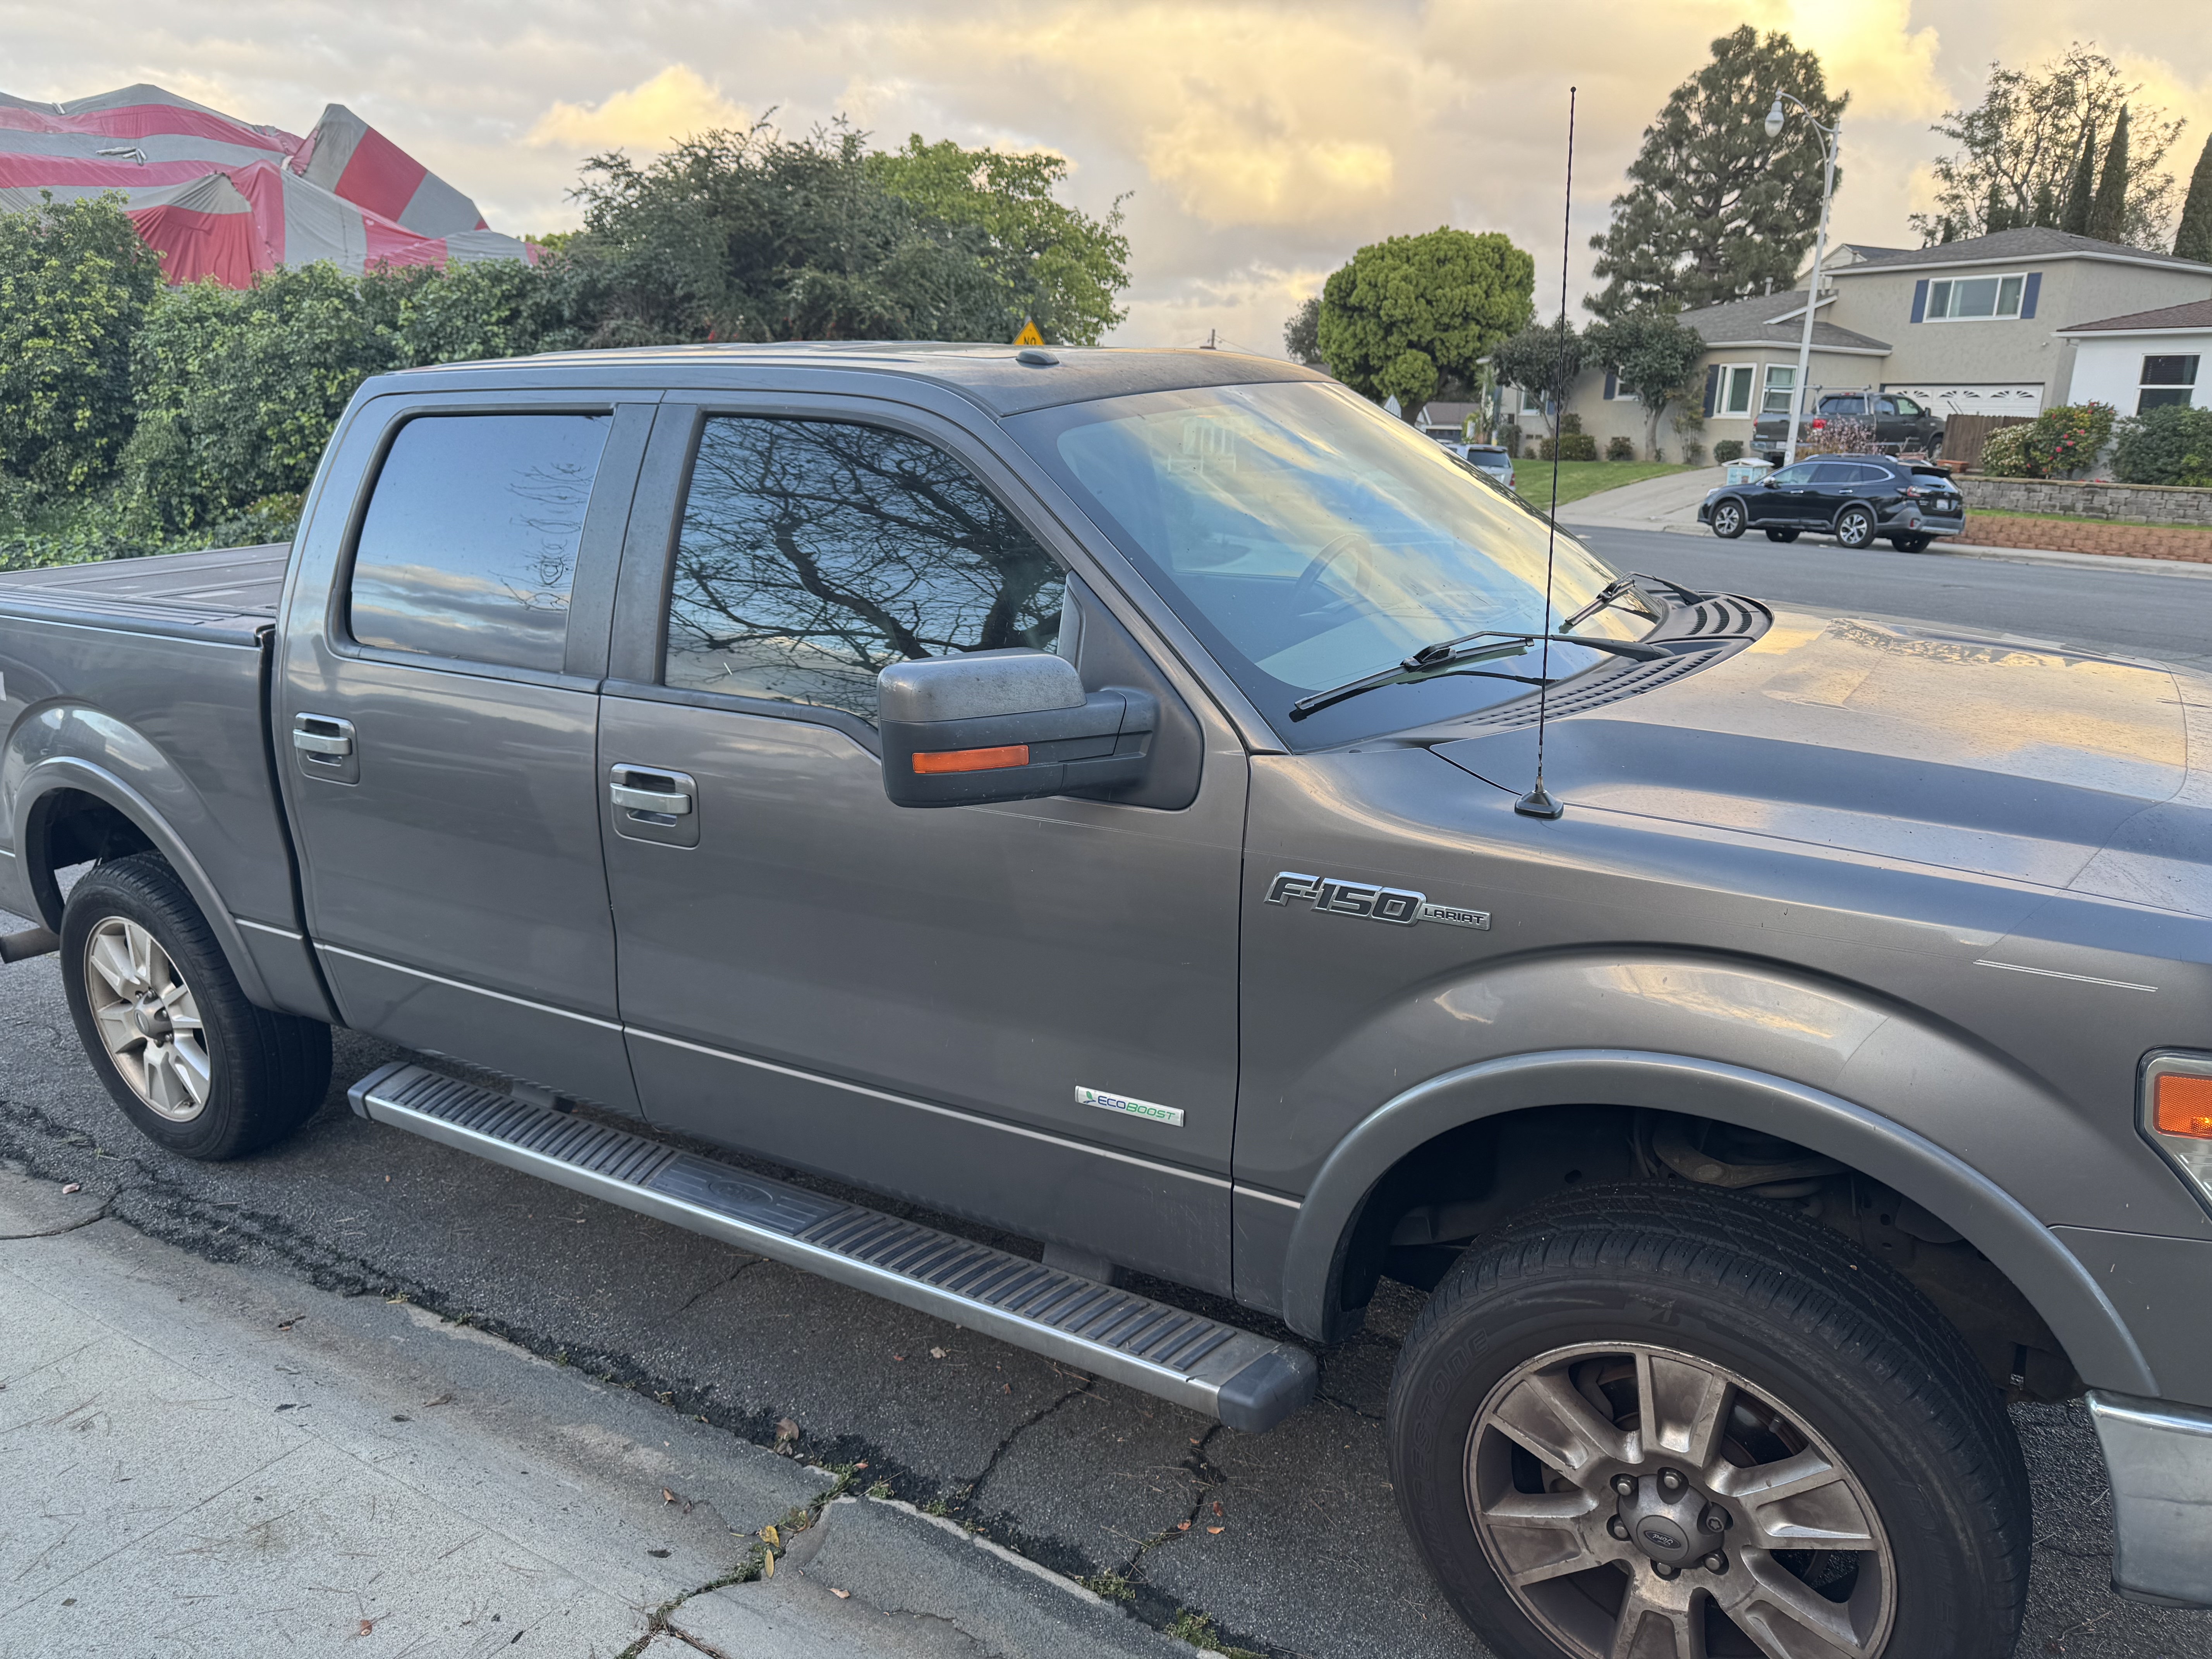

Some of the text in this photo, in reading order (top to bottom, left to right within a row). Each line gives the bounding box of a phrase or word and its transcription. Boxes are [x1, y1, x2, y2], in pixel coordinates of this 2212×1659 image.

[1024, 336, 1037, 345] NO
[1263, 871, 1484, 927] F-150 LARIAT
[1097, 1095, 1175, 1120] ECOBOOST
[1652, 1534, 1673, 1546] Ford
